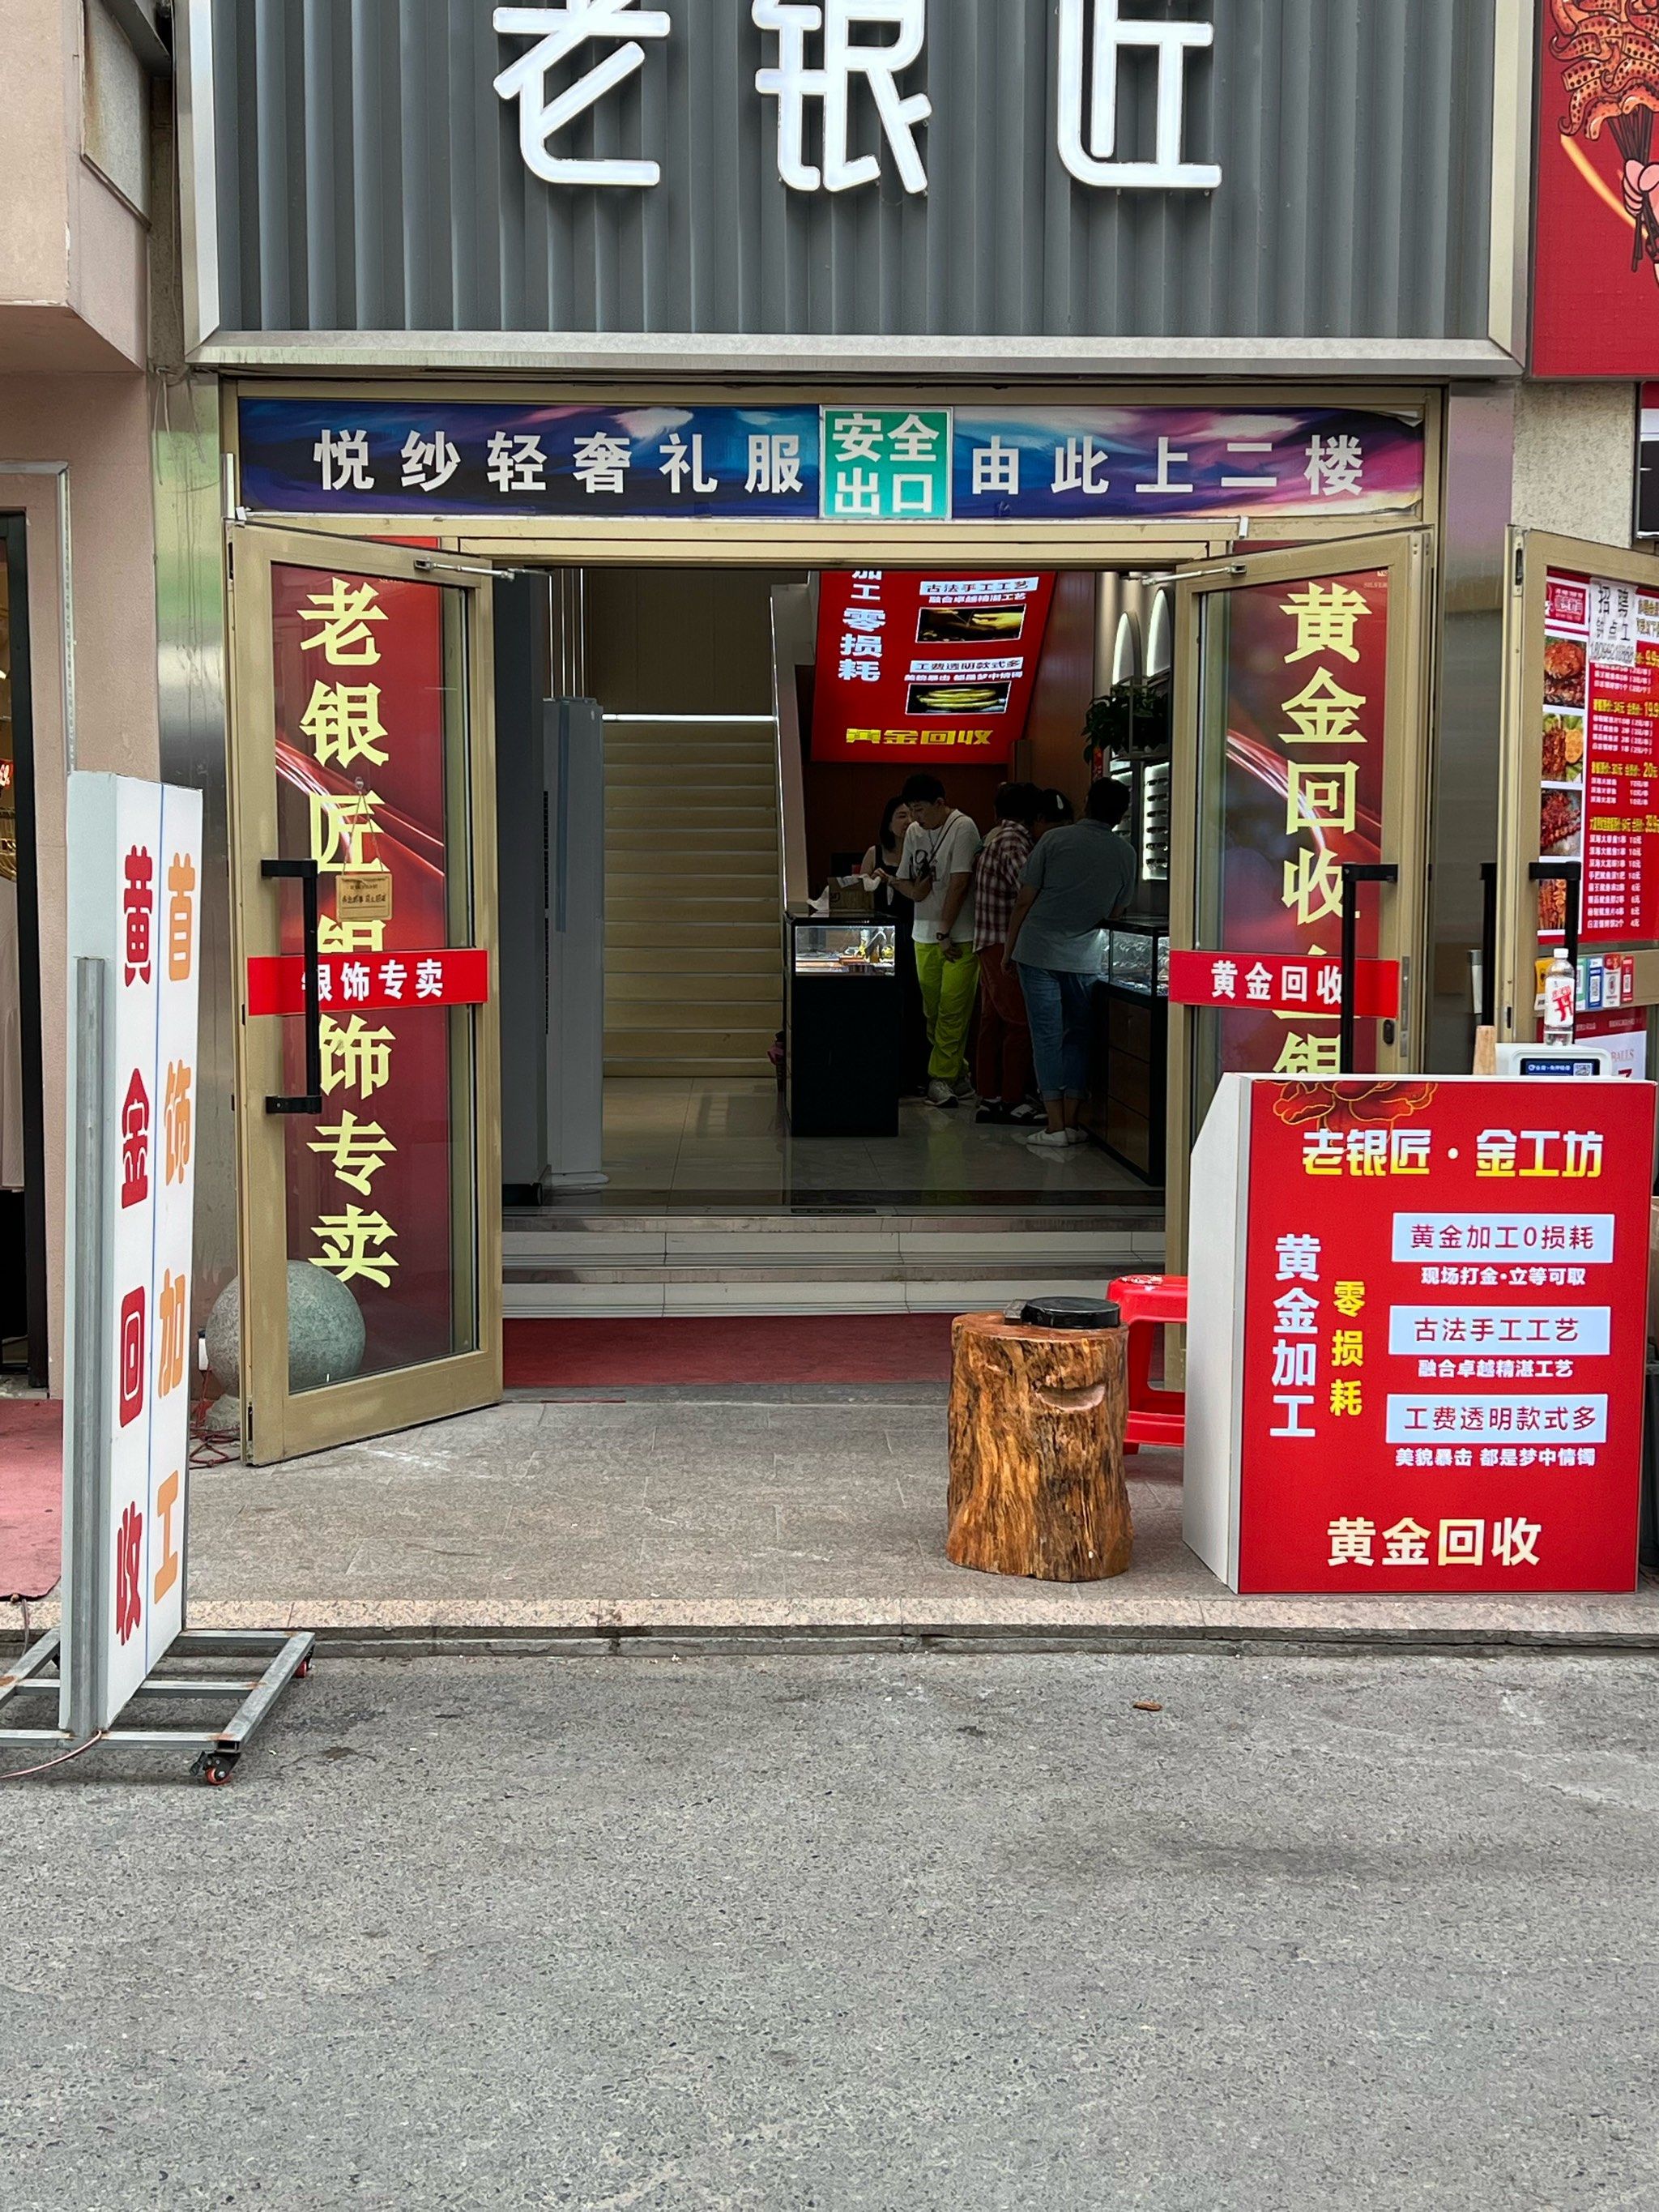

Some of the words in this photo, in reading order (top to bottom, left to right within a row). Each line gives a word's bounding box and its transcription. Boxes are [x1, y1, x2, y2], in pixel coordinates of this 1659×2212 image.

[493, 0, 1222, 193] 老银匠
[313, 429, 804, 493] 悦纱轻奢礼服
[833, 413, 940, 463] 安全
[973, 434, 1366, 497] 由此上二楼
[834, 467, 934, 516] 出口
[927, 579, 1030, 593] 古法手工工艺
[838, 608, 886, 681] 零损耗
[915, 659, 1021, 671] 工费透明款式多
[847, 728, 993, 745] 黄金回收
[1273, 582, 1372, 1074] 黄金回收
[301, 959, 444, 1002] 银饰专卖
[1211, 960, 1342, 1005] 黄金回收
[116, 845, 153, 1646] 黄金回收
[154, 852, 196, 1604] 首饰加工
[1410, 1224, 1594, 1249] 黄金加工0损耗
[1421, 1266, 1586, 1285] 现场打金·立等可取
[1270, 1233, 1321, 1438] 黄金加工
[1329, 1280, 1366, 1416] 零损耗
[1414, 1317, 1579, 1342] 古法手工工艺
[1418, 1359, 1574, 1377] 融合卓越精湛工艺
[1404, 1406, 1596, 1431] 工费透明款式多
[1396, 1447, 1473, 1467] 美貌暴击
[1480, 1447, 1596, 1467] 都是梦中情镯
[1326, 1517, 1542, 1567] 黄金回收
